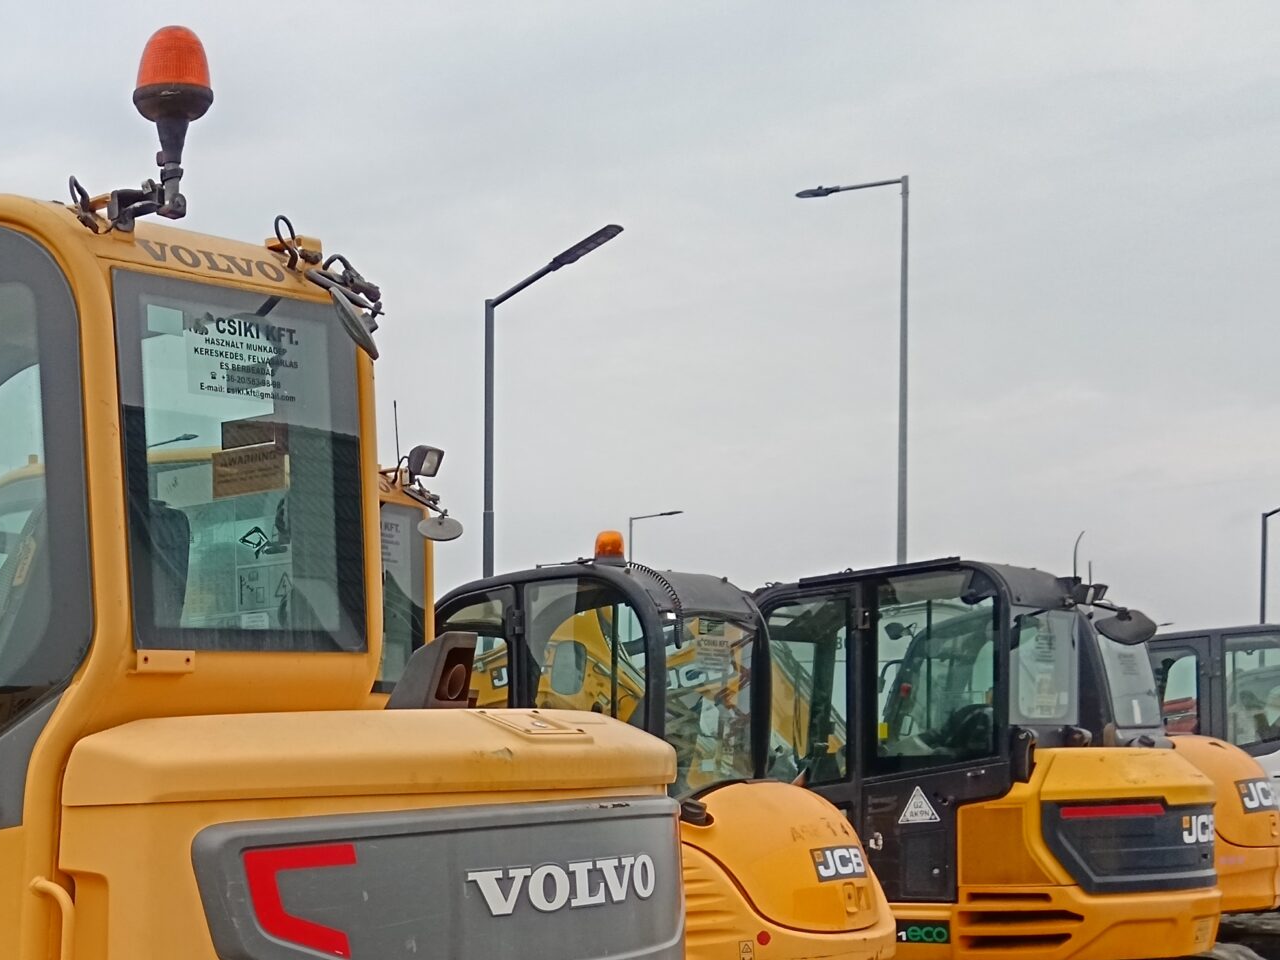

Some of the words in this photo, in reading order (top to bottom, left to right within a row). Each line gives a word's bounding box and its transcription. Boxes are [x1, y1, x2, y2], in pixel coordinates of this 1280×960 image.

[136, 239, 285, 282] VOLVO
[216, 317, 260, 339] CSIKI
[266, 325, 299, 346] KFT.
[817, 848, 866, 878] JCB
[467, 853, 656, 916] VOLVO
